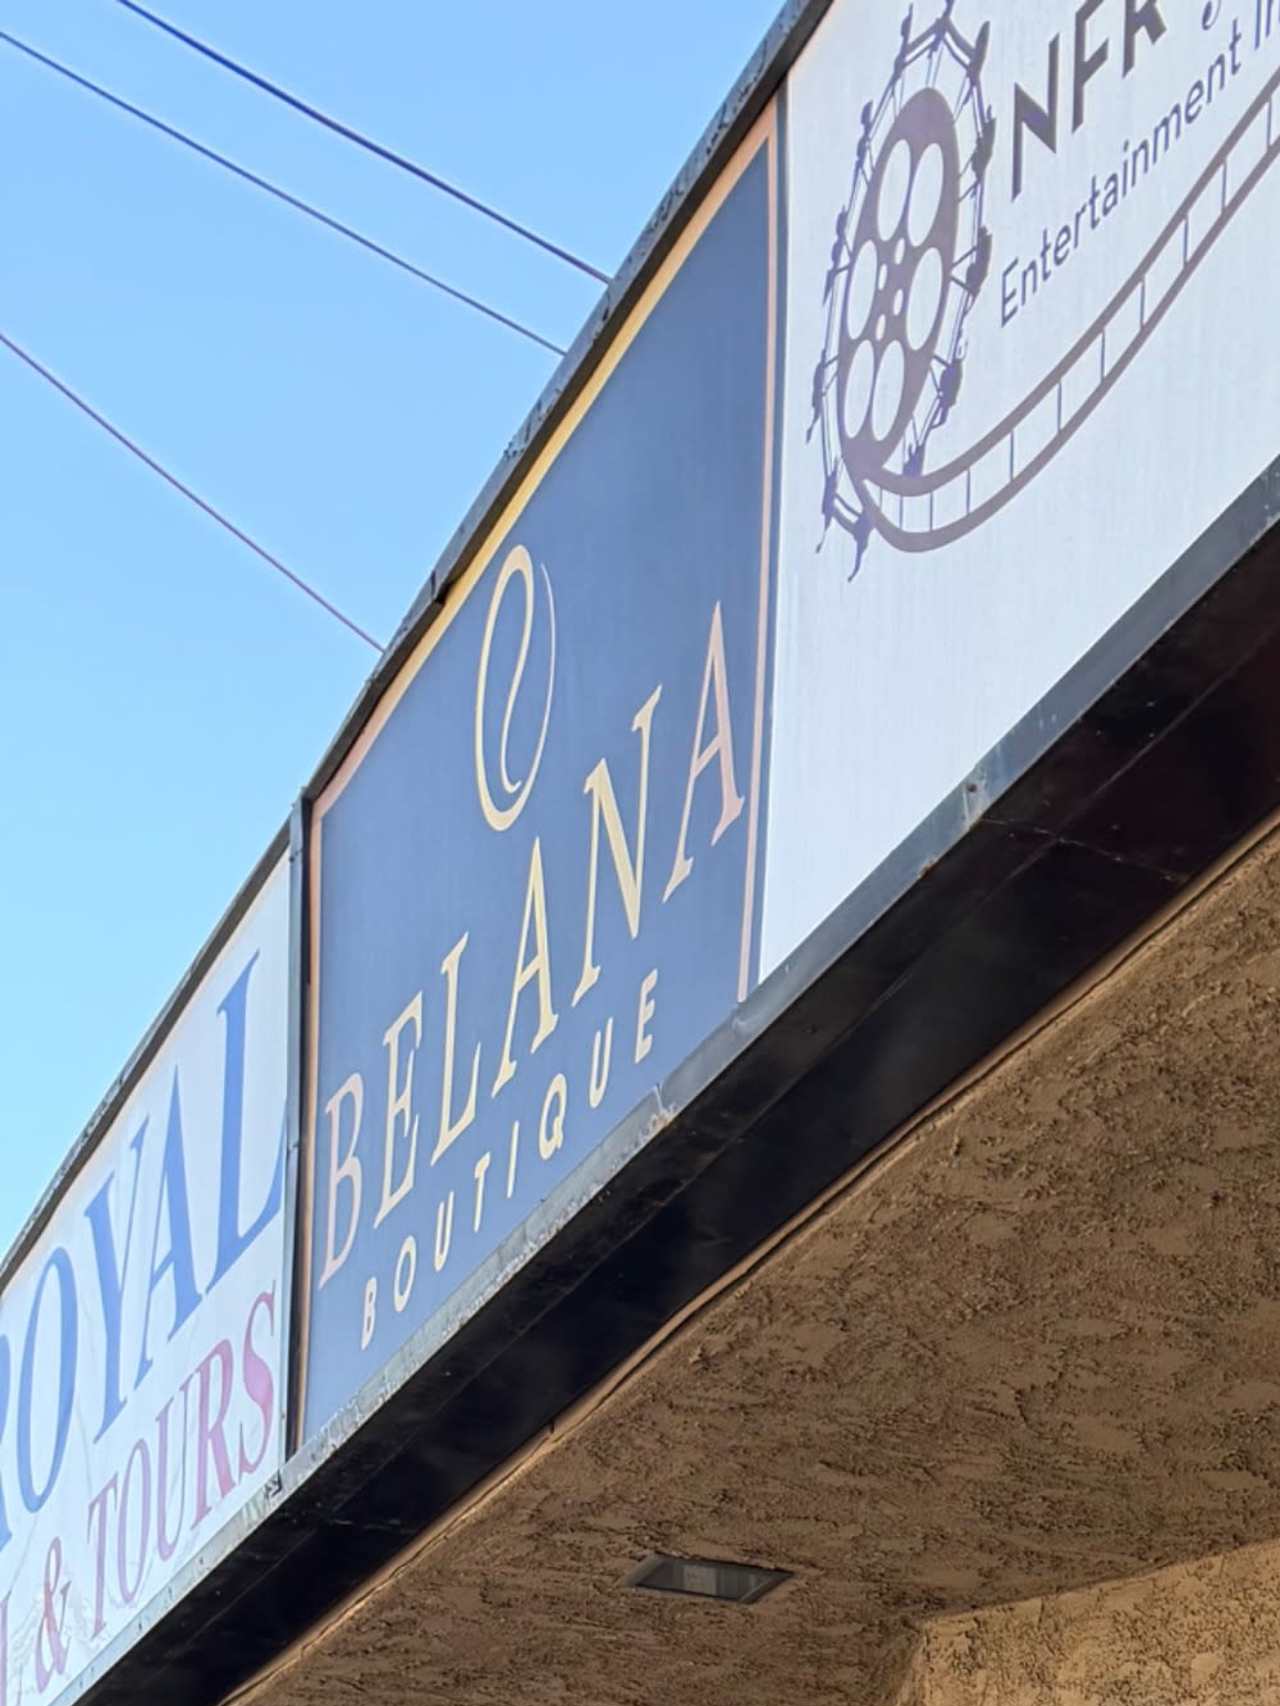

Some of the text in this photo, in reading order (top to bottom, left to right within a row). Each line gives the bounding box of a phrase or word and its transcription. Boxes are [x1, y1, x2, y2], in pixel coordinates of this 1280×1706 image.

[1000, 18, 1242, 329] Entertainment
[318, 600, 745, 1290] BELANA
[0, 947, 287, 1553] OYAL
[360, 967, 659, 1351] BOUTIQUE
[35, 1280, 277, 1695] & TOURS
